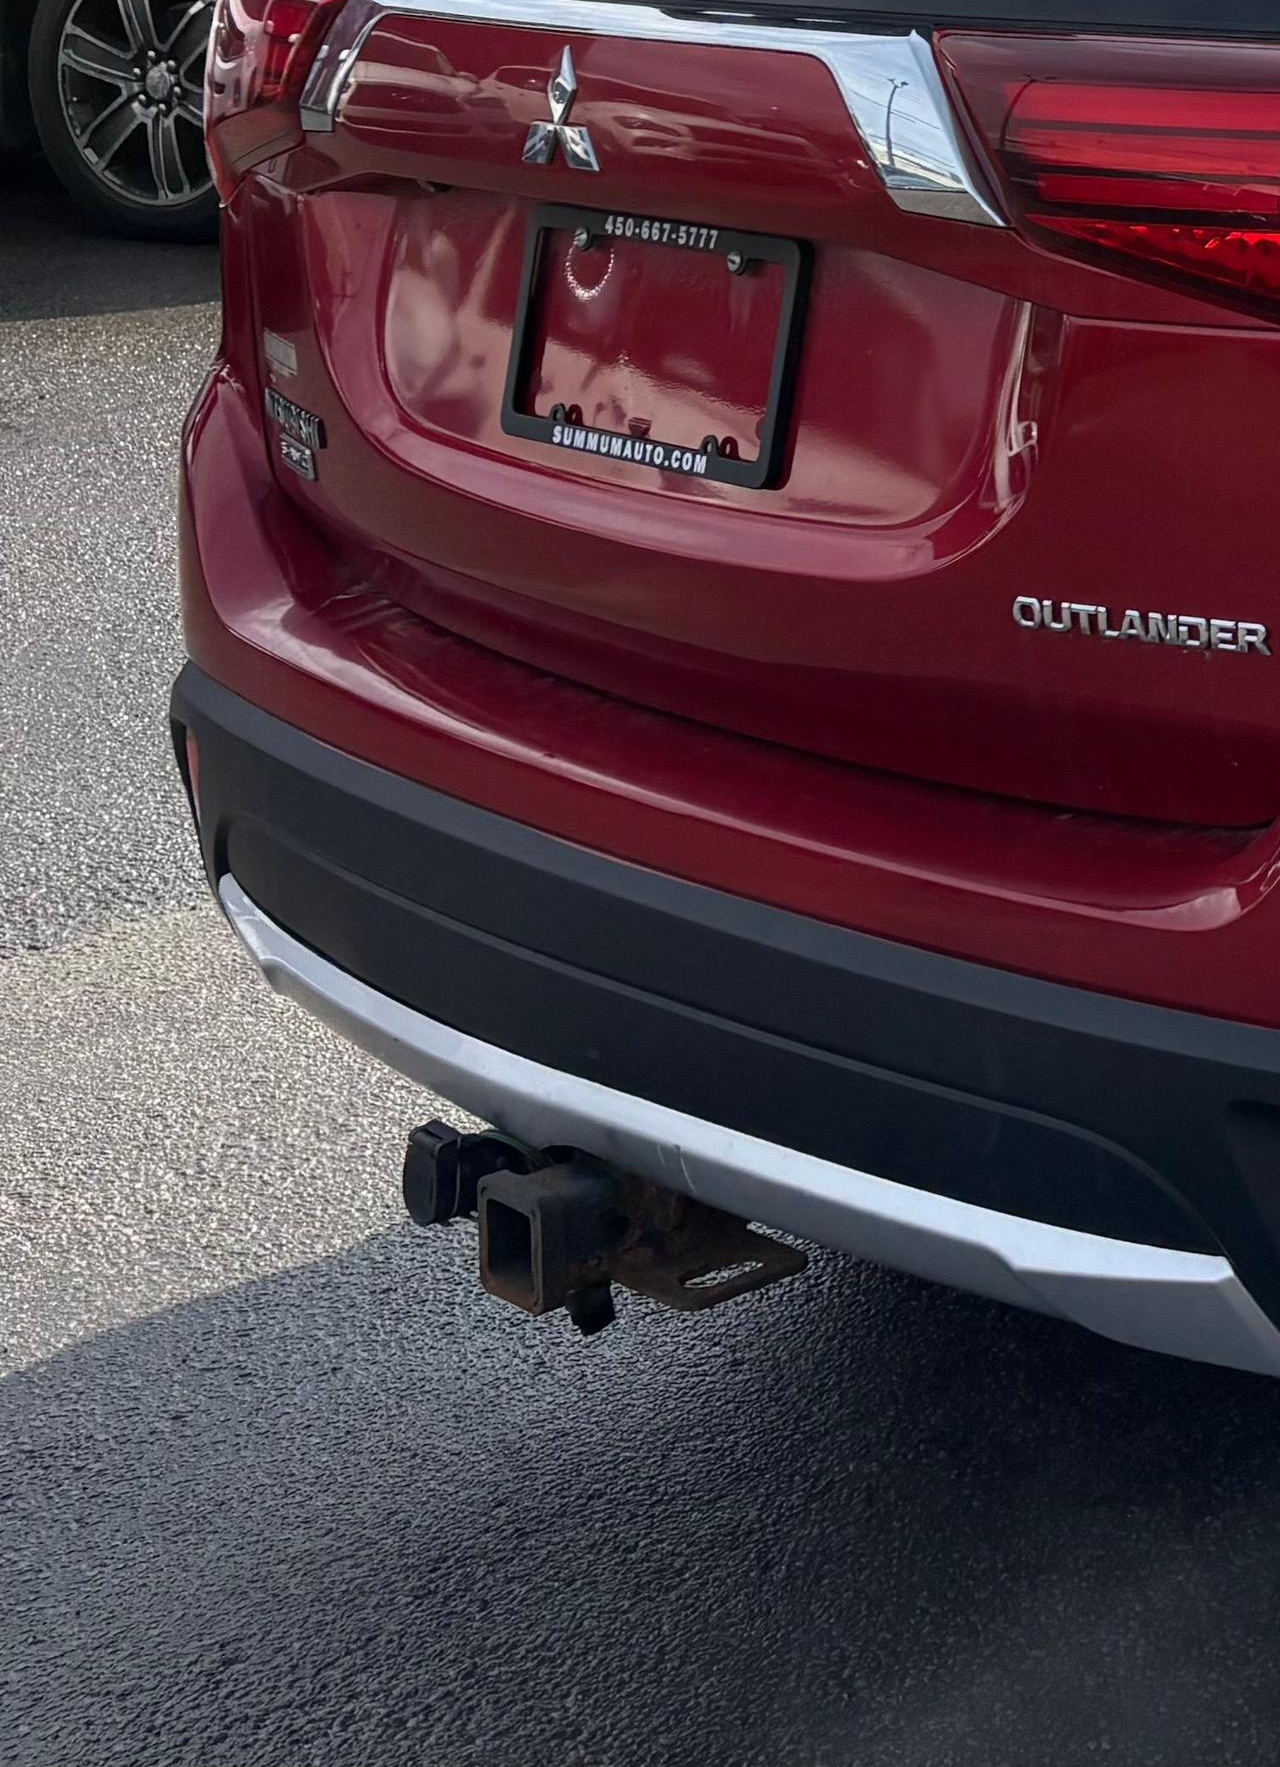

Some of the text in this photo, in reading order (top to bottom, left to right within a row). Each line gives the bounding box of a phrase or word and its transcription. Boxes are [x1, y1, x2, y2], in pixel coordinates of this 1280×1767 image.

[604, 215, 719, 250] 450-667-5777
[552, 424, 708, 475] SUMMUMAUTO.COM
[1012, 595, 1272, 657] OUTLANDER
